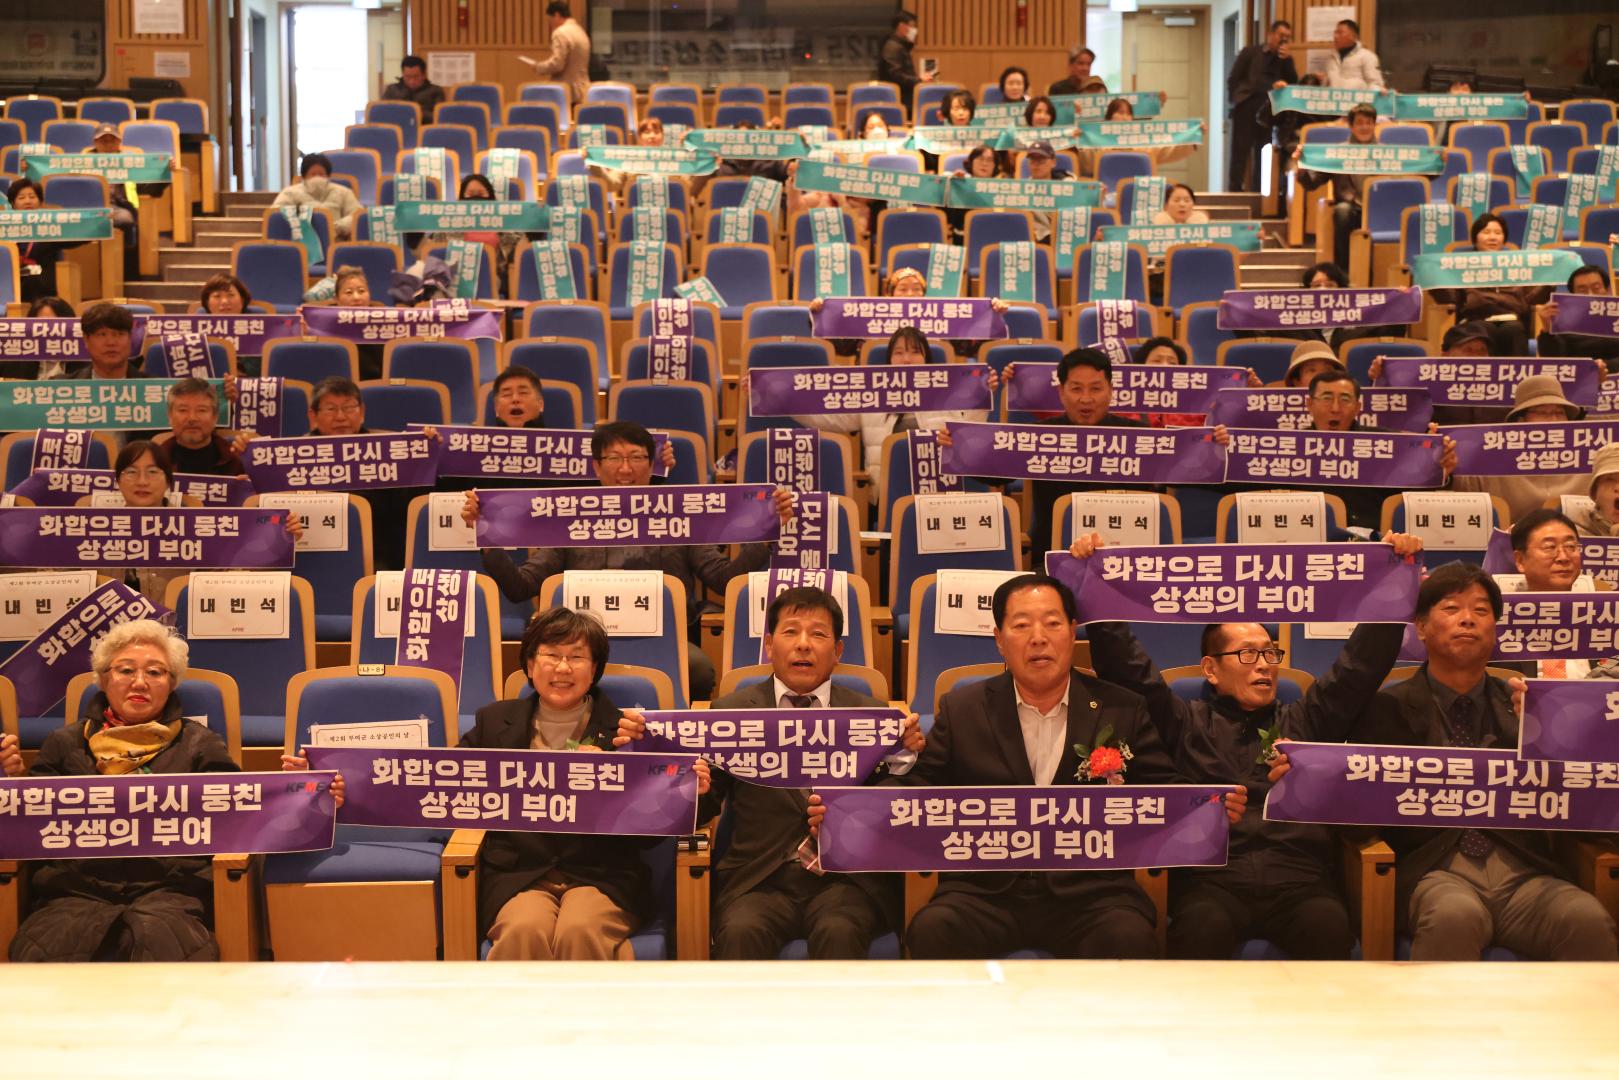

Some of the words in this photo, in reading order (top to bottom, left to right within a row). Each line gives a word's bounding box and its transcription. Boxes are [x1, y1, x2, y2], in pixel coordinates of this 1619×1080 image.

[843, 303, 904, 318] 화합으로
[908, 304, 938, 318] 다시
[942, 303, 973, 318] 뭉친
[32, 322, 66, 338] 다시
[920, 320, 948, 334] 부여
[46, 340, 80, 356] 부여
[794, 374, 868, 391] 화합으로
[872, 372, 906, 389] 다시
[914, 370, 948, 388] 뭉친
[1130, 372, 1165, 389] 다시
[1172, 372, 1208, 390] 뭉친
[1418, 365, 1492, 382] 화합으로
[13, 386, 92, 405] 화합으로
[101, 386, 136, 404] 다시
[823, 392, 880, 410] 상생의
[886, 391, 921, 408] 부여
[1143, 390, 1178, 408] 부여
[1447, 383, 1504, 400] 상생의
[1371, 394, 1408, 412] 뭉친
[46, 406, 107, 424] 상생의
[116, 406, 152, 424] 부여
[448, 434, 528, 454] 화합으로
[535, 436, 572, 456] 다시
[994, 431, 1078, 453] 화합으로
[1086, 433, 1128, 454] 다시
[1135, 434, 1176, 455] 뭉친
[1304, 436, 1344, 457] 다시
[1352, 438, 1394, 459] 뭉친
[1483, 429, 1565, 450] 화합으로
[252, 444, 334, 466] 화합으로
[342, 442, 382, 462] 다시
[389, 439, 428, 460] 뭉친
[1515, 450, 1580, 470] 상생의
[286, 464, 350, 487] 상생의
[358, 462, 398, 484] 부여
[480, 455, 542, 474] 상생의
[550, 456, 588, 476] 부여
[1026, 455, 1092, 475] 상생의
[1100, 456, 1140, 476] 부여
[1247, 456, 1312, 478] 상생의
[1320, 458, 1359, 480] 부여
[187, 482, 228, 502] 뭉친
[531, 495, 622, 518] 화합으로
[630, 494, 674, 515] 다시
[682, 492, 726, 514] 뭉친
[39, 515, 132, 536] 화합으로
[141, 515, 185, 536] 다시
[194, 515, 239, 536] 뭉친
[322, 516, 336, 529] 석
[439, 516, 452, 528] 내
[568, 518, 638, 540] 상생의
[648, 516, 690, 538] 부여
[926, 518, 940, 531] 내
[952, 516, 966, 530] 빈
[978, 516, 992, 528] 석
[1082, 514, 1096, 528] 내
[1108, 516, 1122, 529] 빈
[1134, 516, 1148, 530] 석
[1248, 515, 1261, 528] 내
[1274, 515, 1288, 528] 빈
[1300, 515, 1314, 528] 석
[1416, 514, 1429, 528] 내
[1442, 514, 1456, 528] 빈
[1467, 514, 1480, 528] 석
[77, 540, 149, 560] 상생의
[159, 540, 202, 560] 부여
[1102, 554, 1222, 582] 화합으로
[1234, 554, 1293, 582] 다시
[1305, 553, 1364, 582] 뭉친
[6, 600, 20, 614] 내
[36, 598, 52, 614] 빈
[200, 598, 216, 613] 내
[230, 598, 246, 614] 빈
[260, 598, 276, 613] 석
[604, 596, 620, 610] 빈
[634, 596, 649, 611] 석
[948, 594, 963, 608] 내
[1151, 586, 1244, 614] 상생의
[1257, 586, 1314, 614] 부여
[406, 569, 436, 662] 화합으로
[37, 588, 126, 666] 화합으로
[1498, 628, 1580, 652] 상생의
[778, 719, 836, 748] 다시
[372, 758, 488, 788] 화합으로
[500, 760, 556, 789] 다시
[567, 762, 625, 791] 뭉친
[801, 750, 858, 779] 부여
[1346, 754, 1474, 786] 화합으로
[1487, 760, 1549, 788] 다시
[128, 785, 188, 812] 다시
[201, 783, 262, 811] 뭉친
[419, 792, 510, 820] 상생의
[521, 794, 577, 824] 부여
[1396, 790, 1496, 818] 상생의
[1508, 790, 1570, 820] 부여
[890, 797, 1018, 828] 화합으로
[1030, 798, 1091, 826] 다시
[1103, 796, 1166, 826] 뭉친
[40, 818, 140, 848] 상생의
[152, 816, 212, 846] 부여
[941, 830, 1040, 861] 상생의
[1053, 829, 1115, 860] 부여
